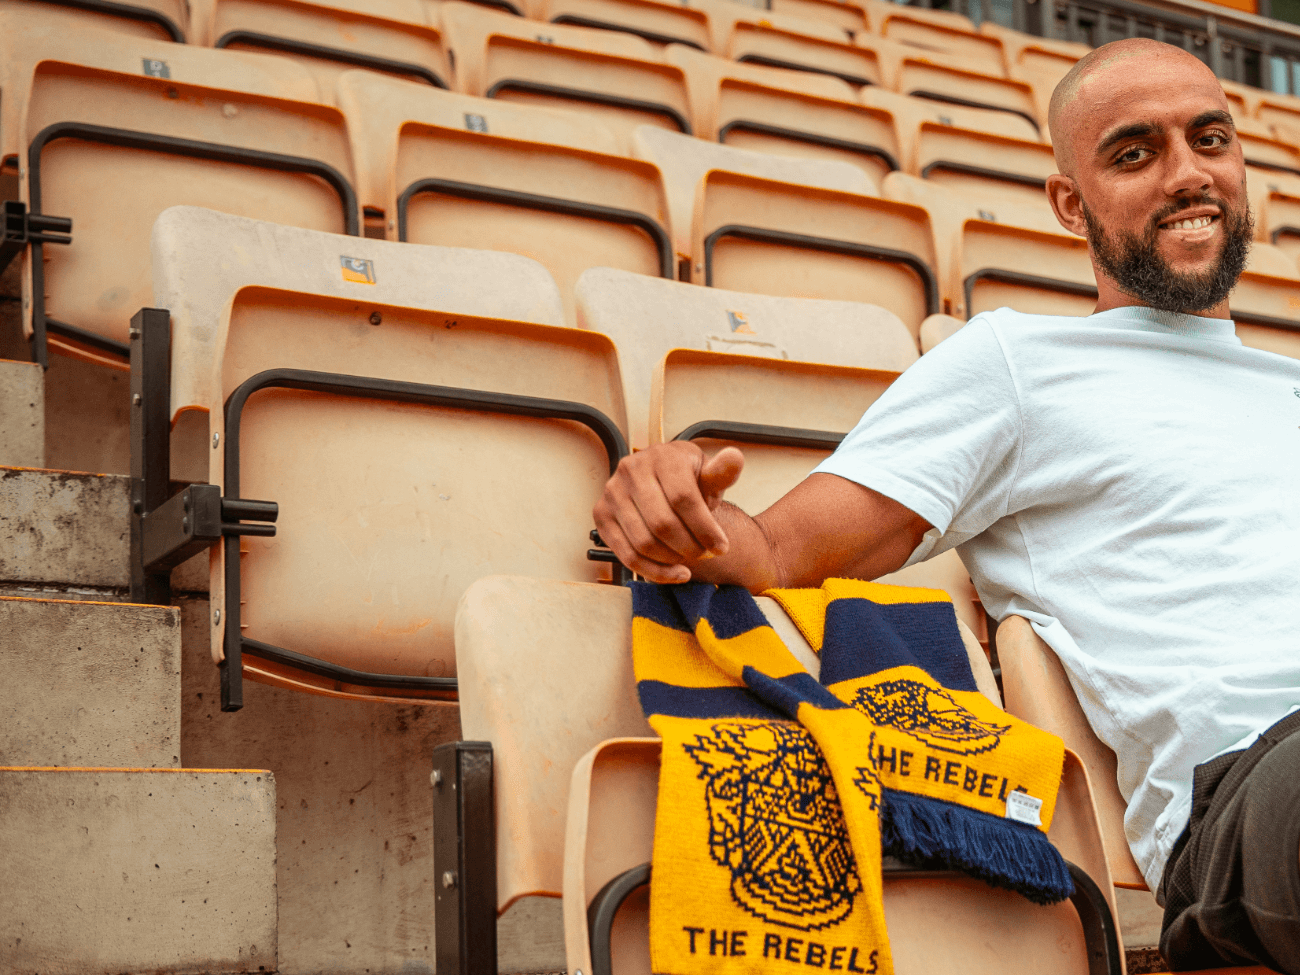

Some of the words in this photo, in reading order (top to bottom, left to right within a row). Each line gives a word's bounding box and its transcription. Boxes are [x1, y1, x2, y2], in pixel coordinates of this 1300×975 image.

[877, 744, 914, 777] HE
[924, 755, 1028, 803] REBEL
[682, 926, 748, 957] THE
[762, 932, 879, 974] REBELS
